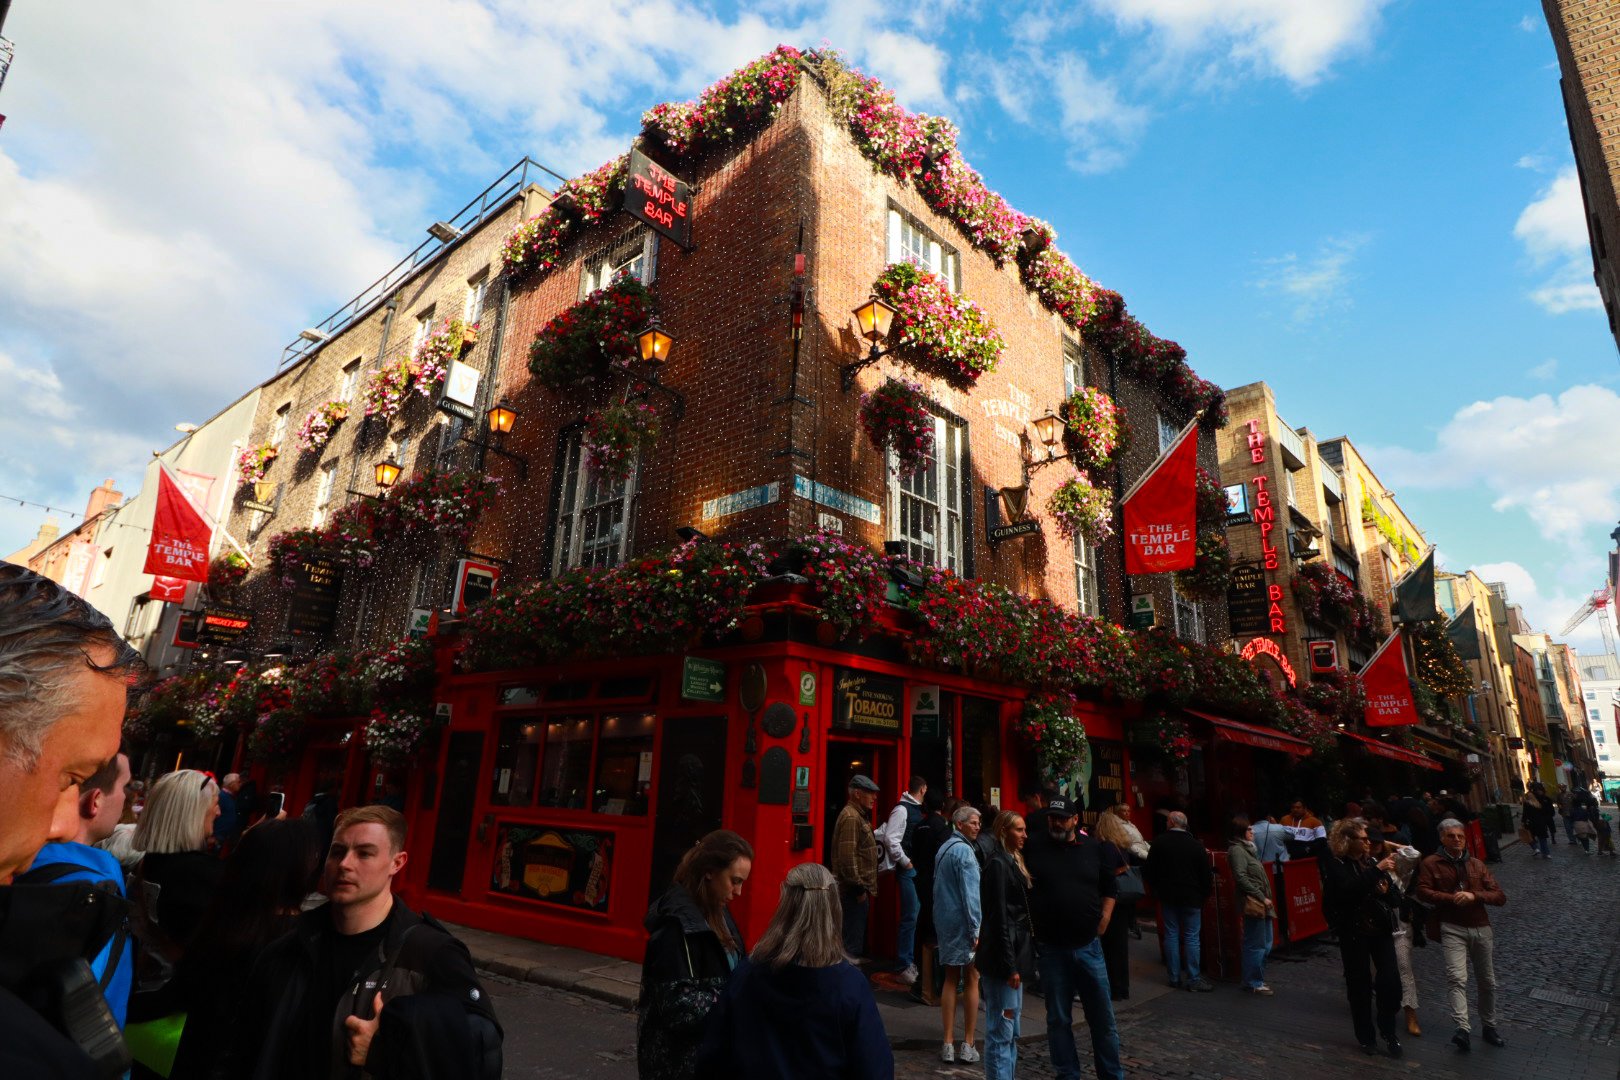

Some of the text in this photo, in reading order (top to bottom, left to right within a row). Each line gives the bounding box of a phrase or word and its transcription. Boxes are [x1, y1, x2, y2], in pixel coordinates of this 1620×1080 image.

[650, 163, 677, 192] THE
[634, 173, 688, 217] TEMPLE
[645, 201, 673, 228] BAR
[1008, 383, 1032, 410] THE
[442, 400, 474, 418] GUINNESS
[981, 399, 1031, 425] TEMPLE
[994, 524, 1031, 538] GUINNESS
[1148, 523, 1174, 533] THE
[1246, 418, 1285, 633] THE TEMPLE BAR
[173, 539, 192, 551] THE
[1130, 529, 1191, 545] TEMPLE
[154, 543, 205, 563] TEMPLE
[1144, 544, 1176, 556] BAR
[166, 555, 193, 568] BAR
[310, 575, 332, 585] BAR
[232, 619, 249, 629] SHOP
[1241, 637, 1296, 688] THE TEMPLE BAR
[847, 692, 895, 719] TOBACCO
[1368, 698, 1409, 708] TEMPLE
[1378, 707, 1401, 715] BAR
